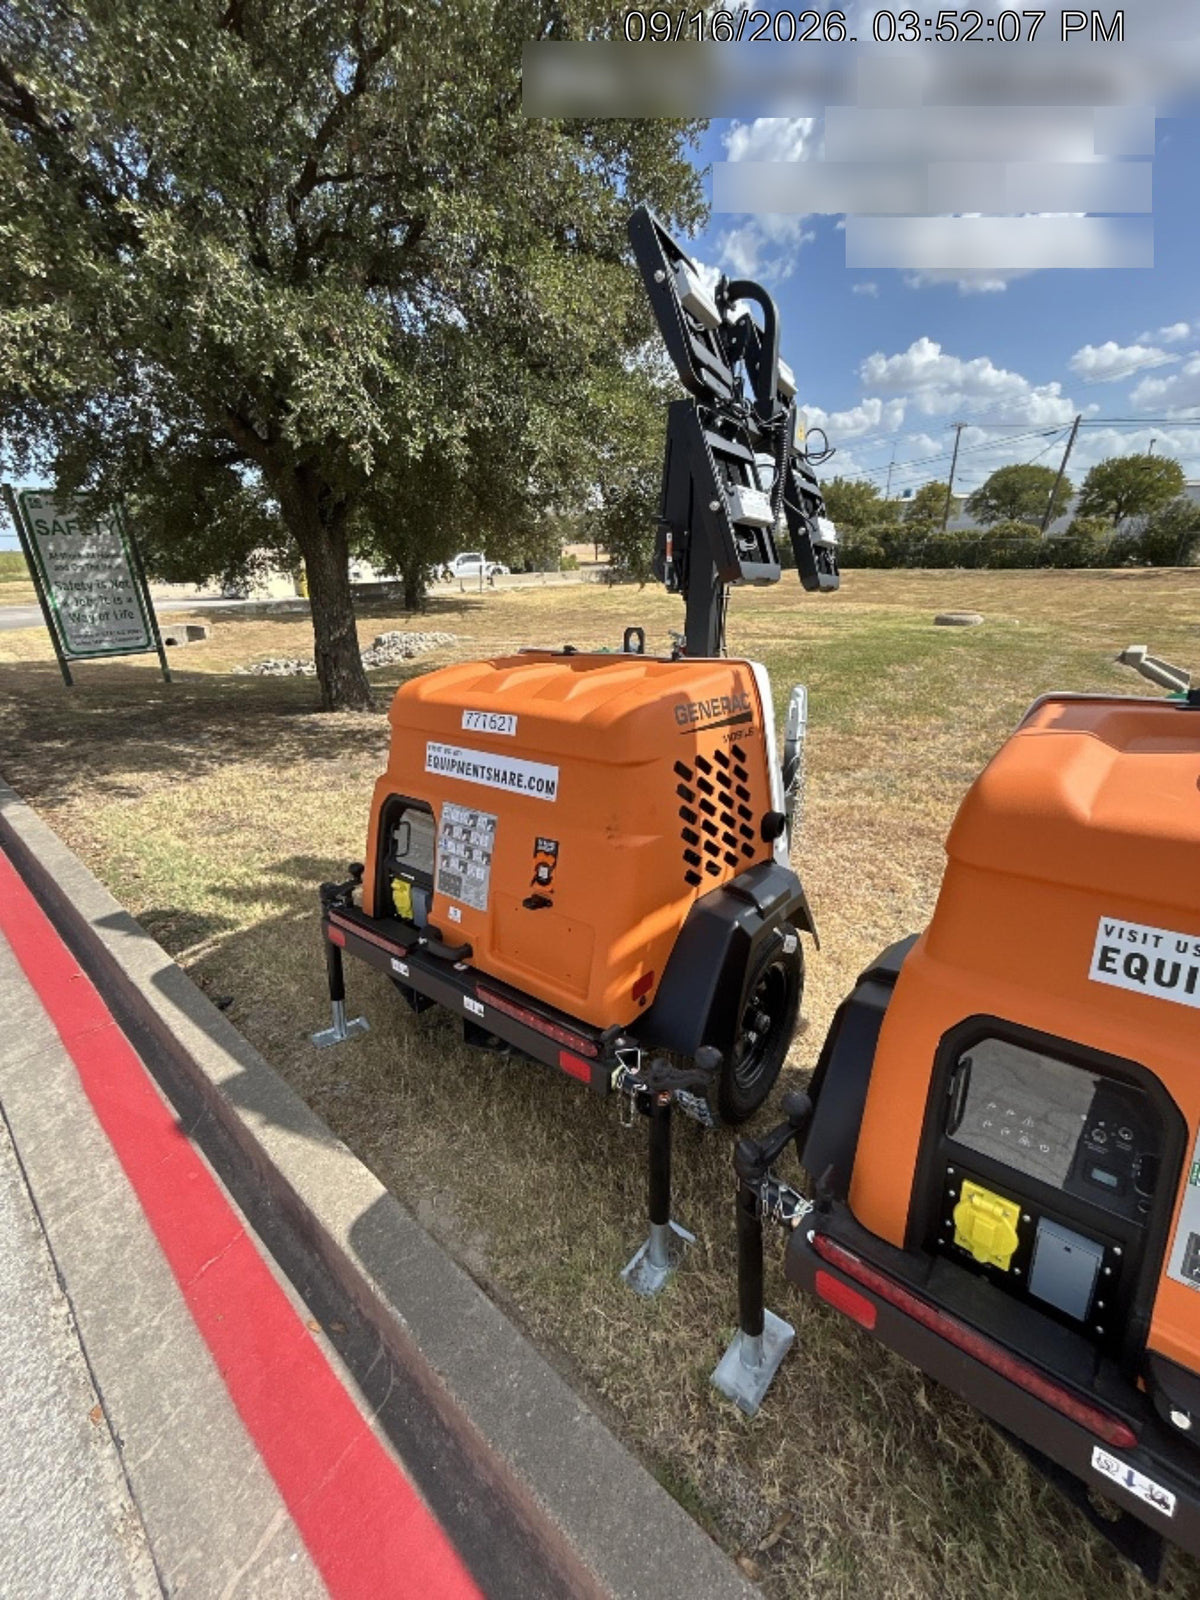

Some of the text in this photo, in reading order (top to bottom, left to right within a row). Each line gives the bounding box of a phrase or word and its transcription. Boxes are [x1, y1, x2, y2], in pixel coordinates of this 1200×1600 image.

[54, 580, 93, 592] Safety
[113, 596, 123, 604] is
[68, 609, 135, 624] Way of Life
[674, 692, 751, 726] GENERAC
[427, 754, 556, 796] EQUIPMENTSHARE.COM
[1104, 924, 1200, 957] VISIT US
[1097, 945, 1200, 995] EQUI
